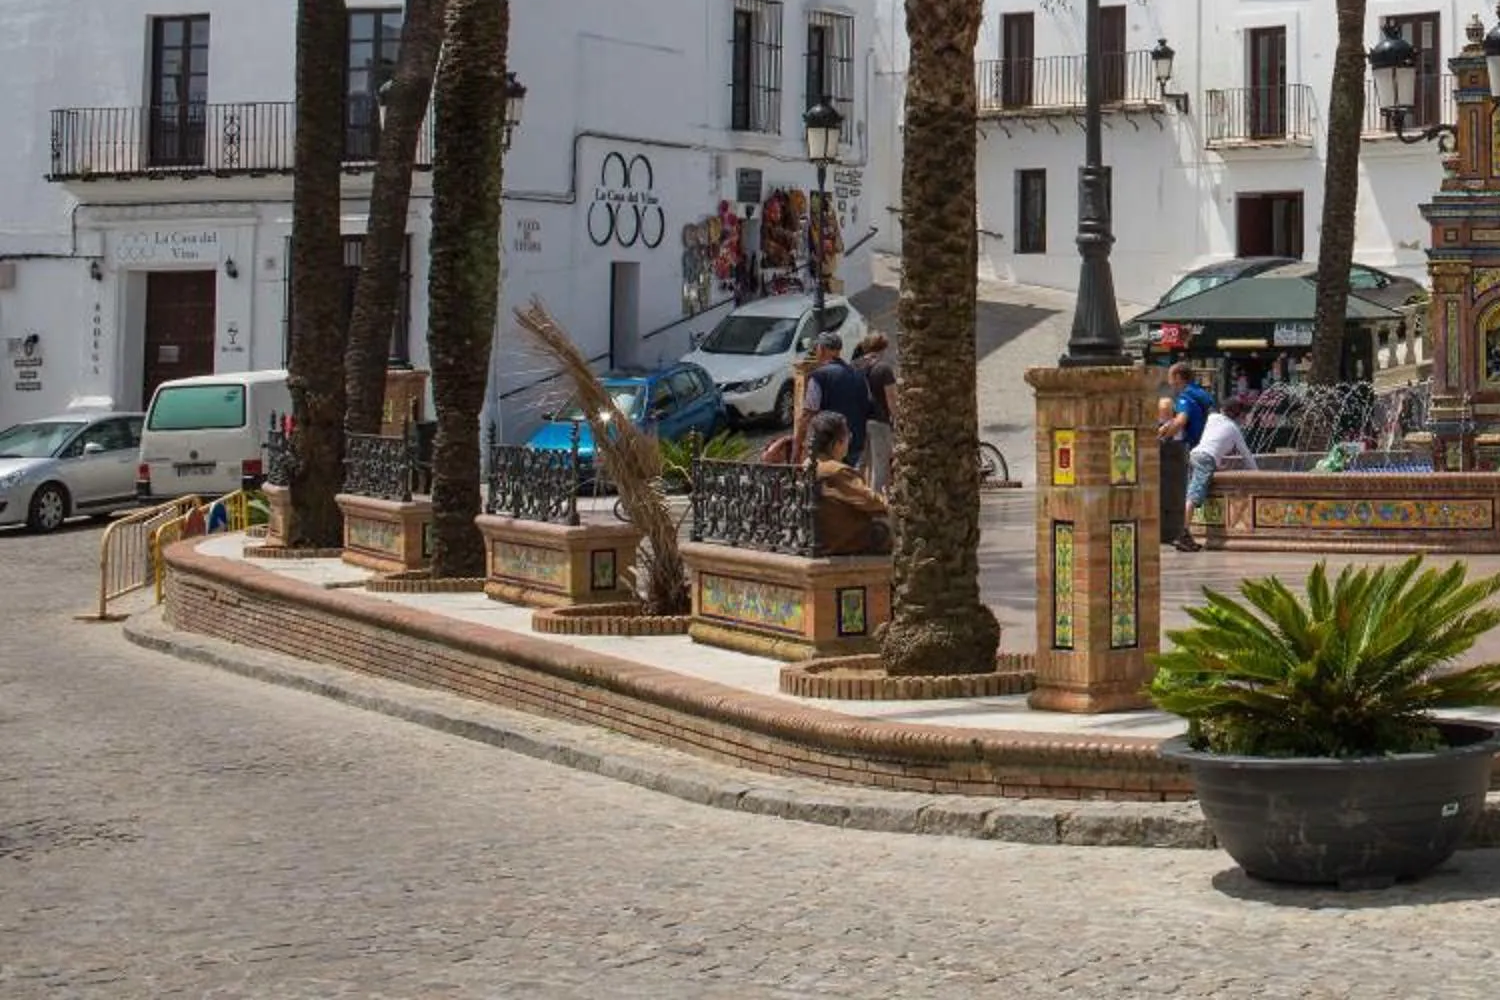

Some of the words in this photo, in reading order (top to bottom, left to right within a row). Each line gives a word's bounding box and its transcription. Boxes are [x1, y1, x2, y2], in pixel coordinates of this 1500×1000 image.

[596, 187, 606, 201] La
[607, 189, 625, 202] Casa
[628, 191, 638, 203] del
[641, 191, 659, 204] Vino
[155, 231, 169, 244] La
[170, 231, 197, 243] Casa
[199, 231, 217, 243] del
[171, 247, 199, 259] Vino
